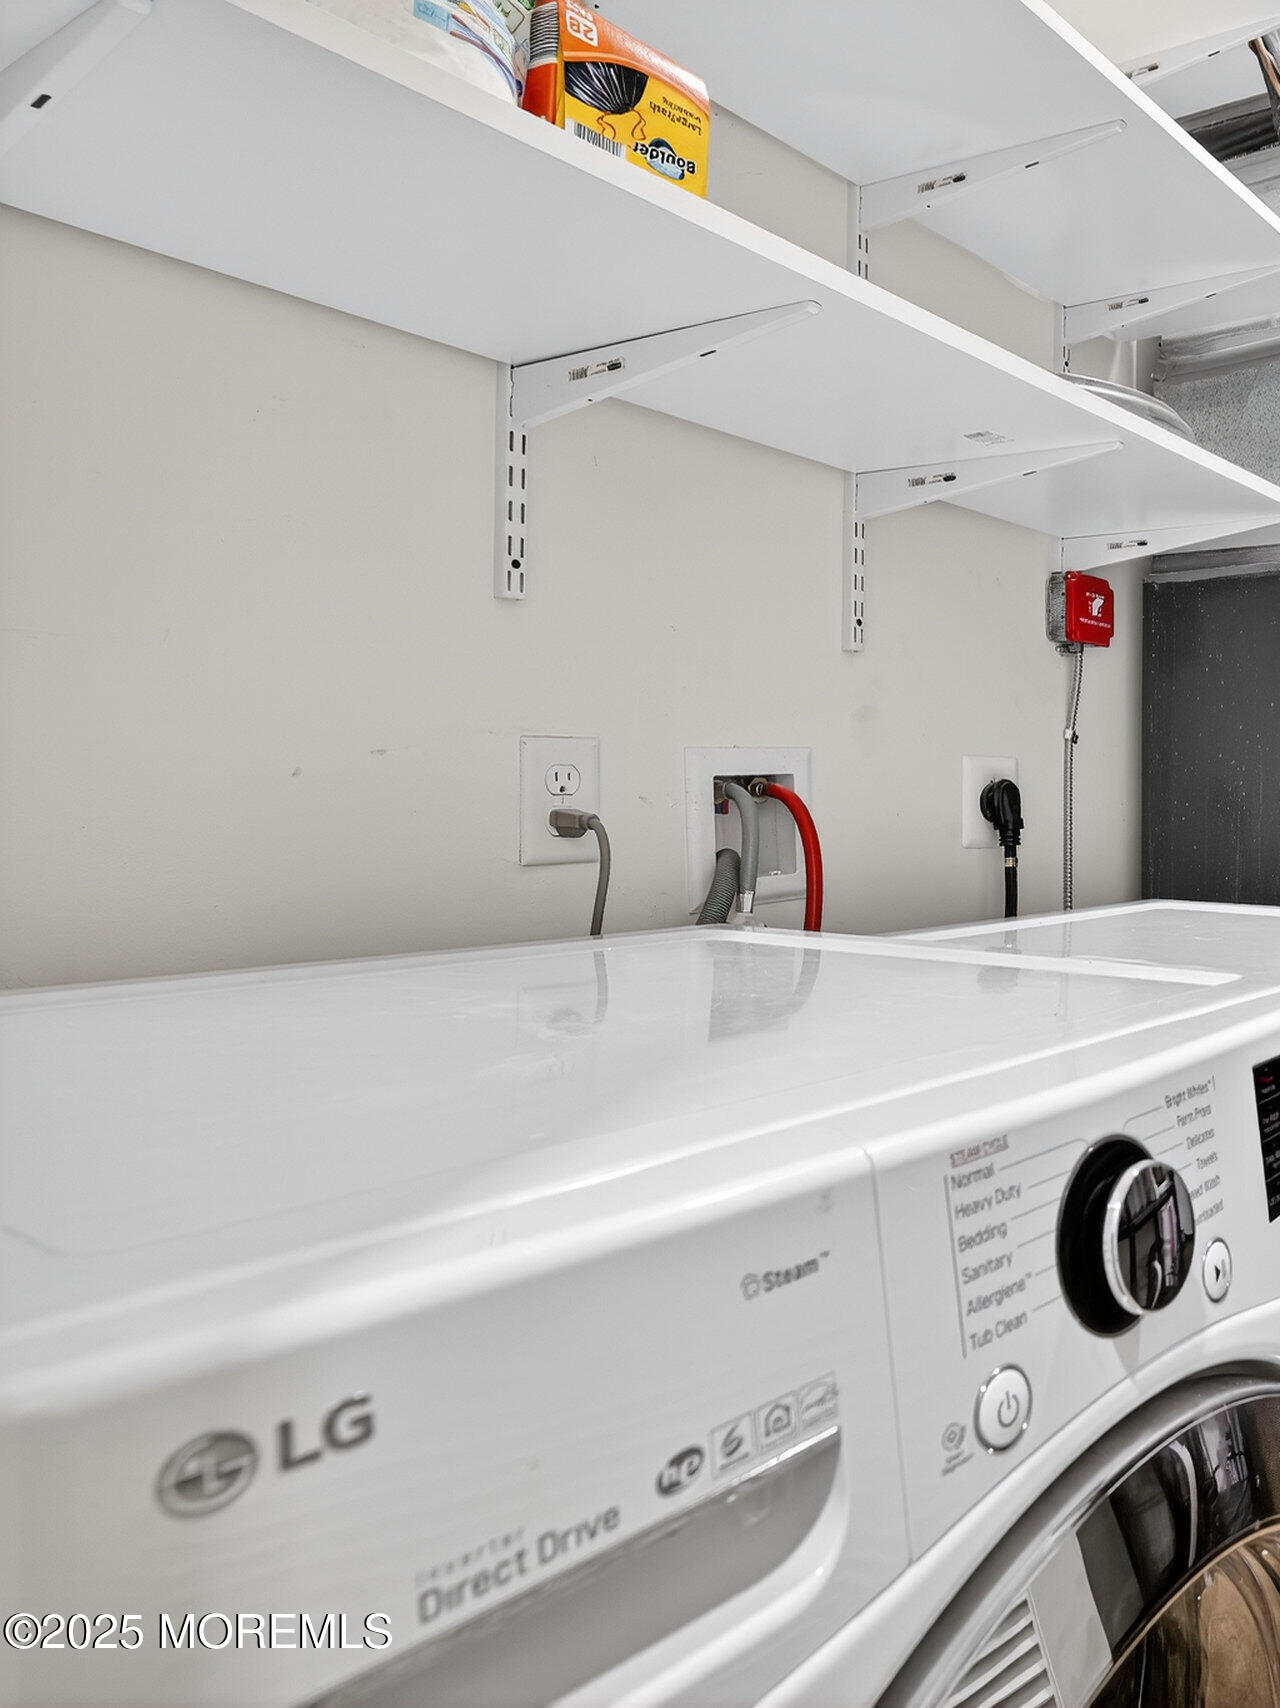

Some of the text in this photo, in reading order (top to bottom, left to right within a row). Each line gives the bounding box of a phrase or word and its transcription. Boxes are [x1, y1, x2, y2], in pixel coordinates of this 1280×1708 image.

[632, 142, 697, 176] Boulder
[951, 1163, 995, 1191] Normal
[955, 1182, 1022, 1222] Heavy Duty
[957, 1221, 1008, 1254] Bedding
[961, 1251, 1013, 1286] Sanitary
[969, 1310, 1028, 1352] Tub Clean
[276, 1392, 376, 1472] LG
[416, 1504, 621, 1625] Direct Drive
